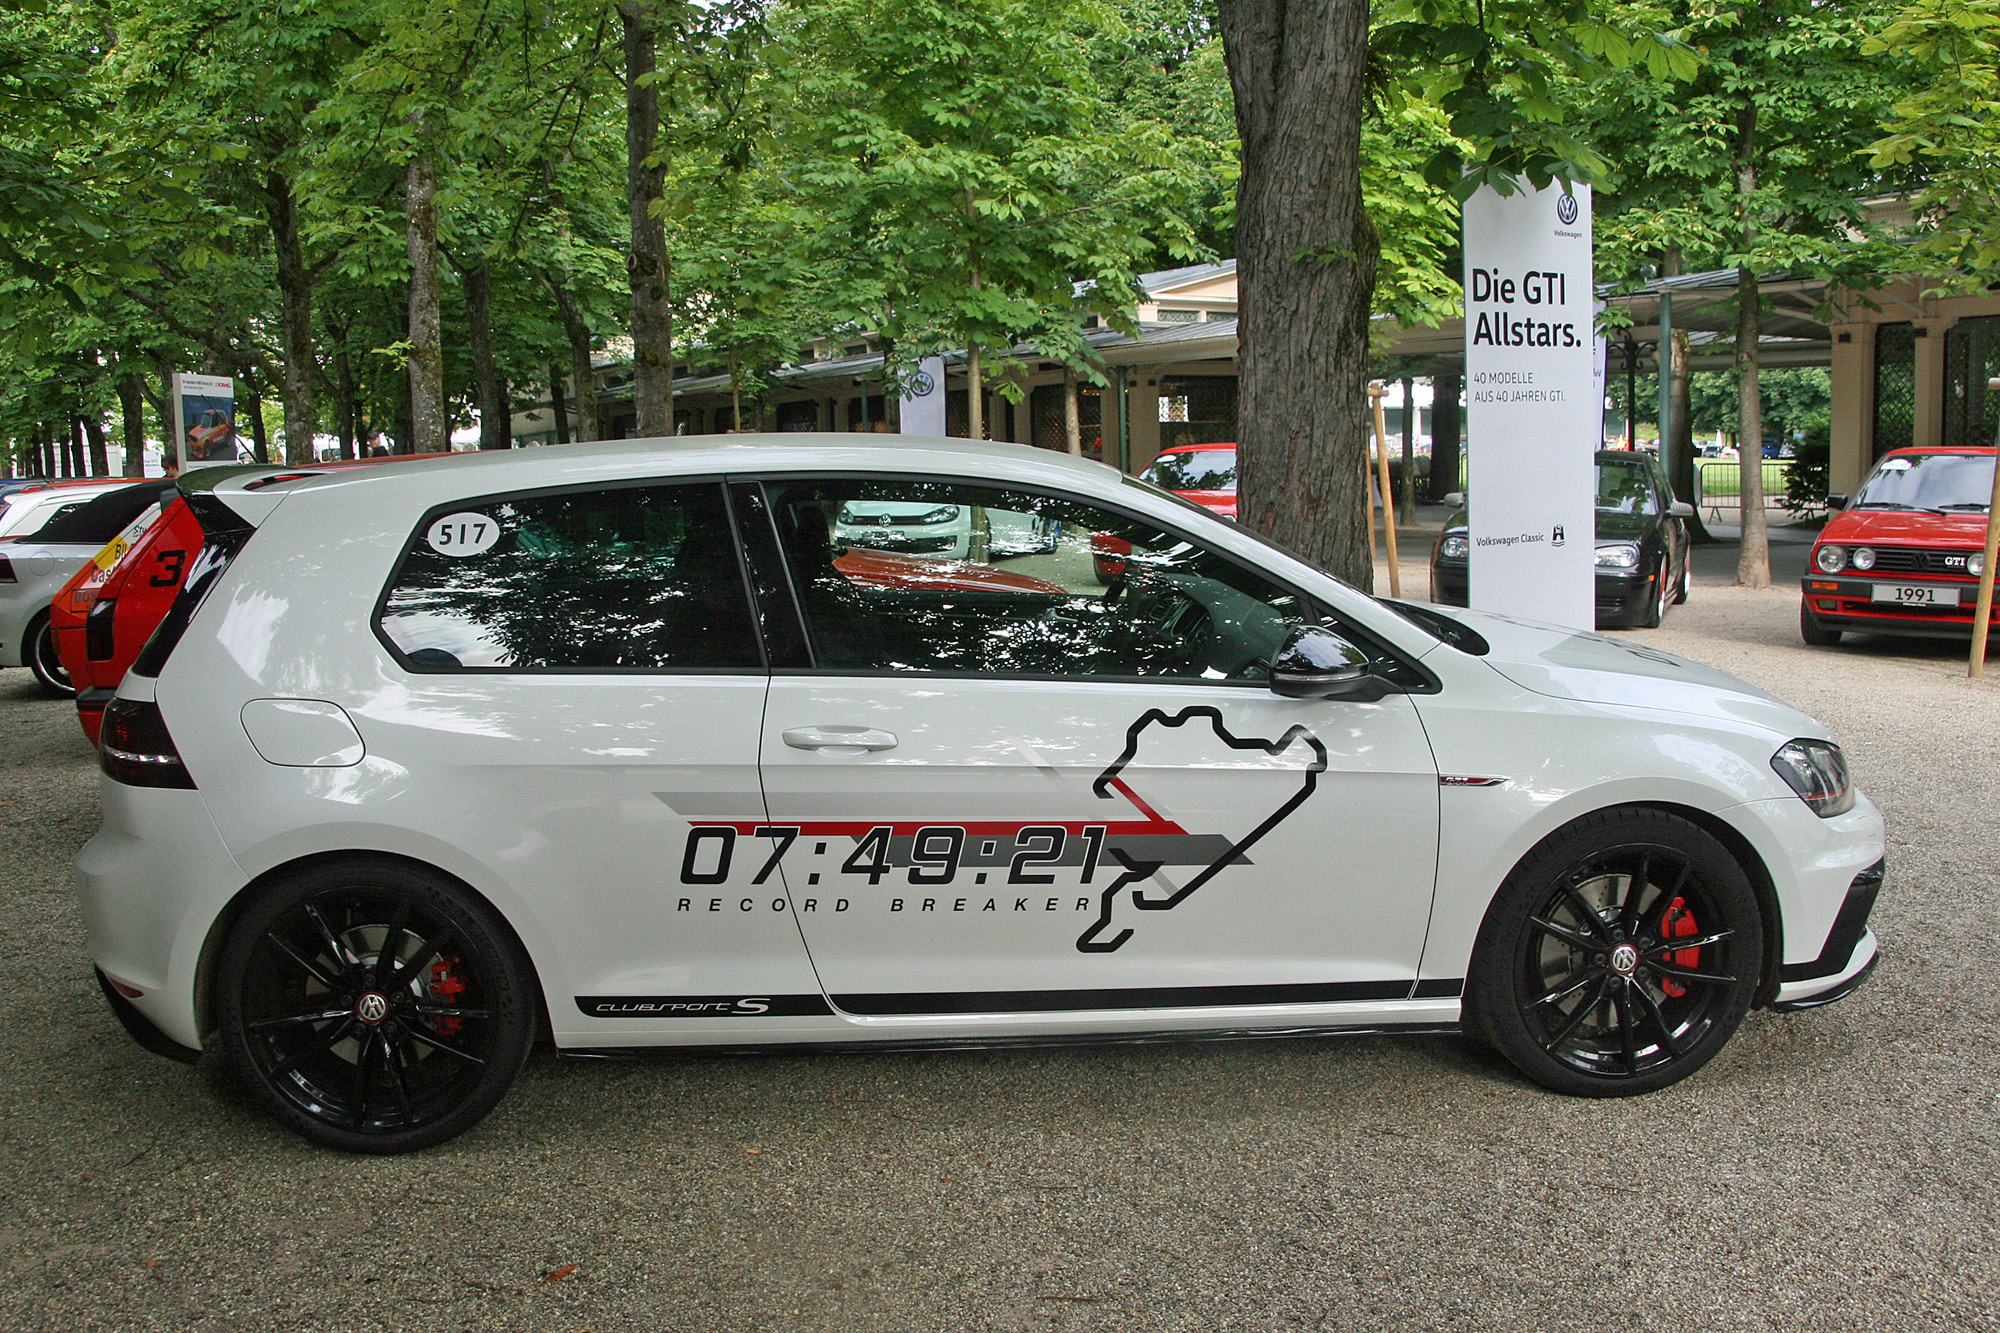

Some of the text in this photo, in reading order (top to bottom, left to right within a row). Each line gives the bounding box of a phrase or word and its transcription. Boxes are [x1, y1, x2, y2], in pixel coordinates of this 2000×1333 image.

[1553, 229, 1583, 239] Volkswagen
[1472, 268, 1566, 306] Die GTI
[1473, 312, 1582, 348] Allstars.
[1474, 372, 1534, 384] 40 MODELLE
[1474, 390, 1567, 403] AUS 40 JAHREN GTI.
[439, 523, 487, 546] 517
[1476, 532, 1545, 547] Volkswagen Classic
[150, 550, 187, 588] 3
[1944, 556, 1966, 567] GTI
[1895, 587, 1935, 602] 1991
[679, 825, 1107, 886] 07:49:21
[677, 897, 1090, 912] RECORD BREAKER
